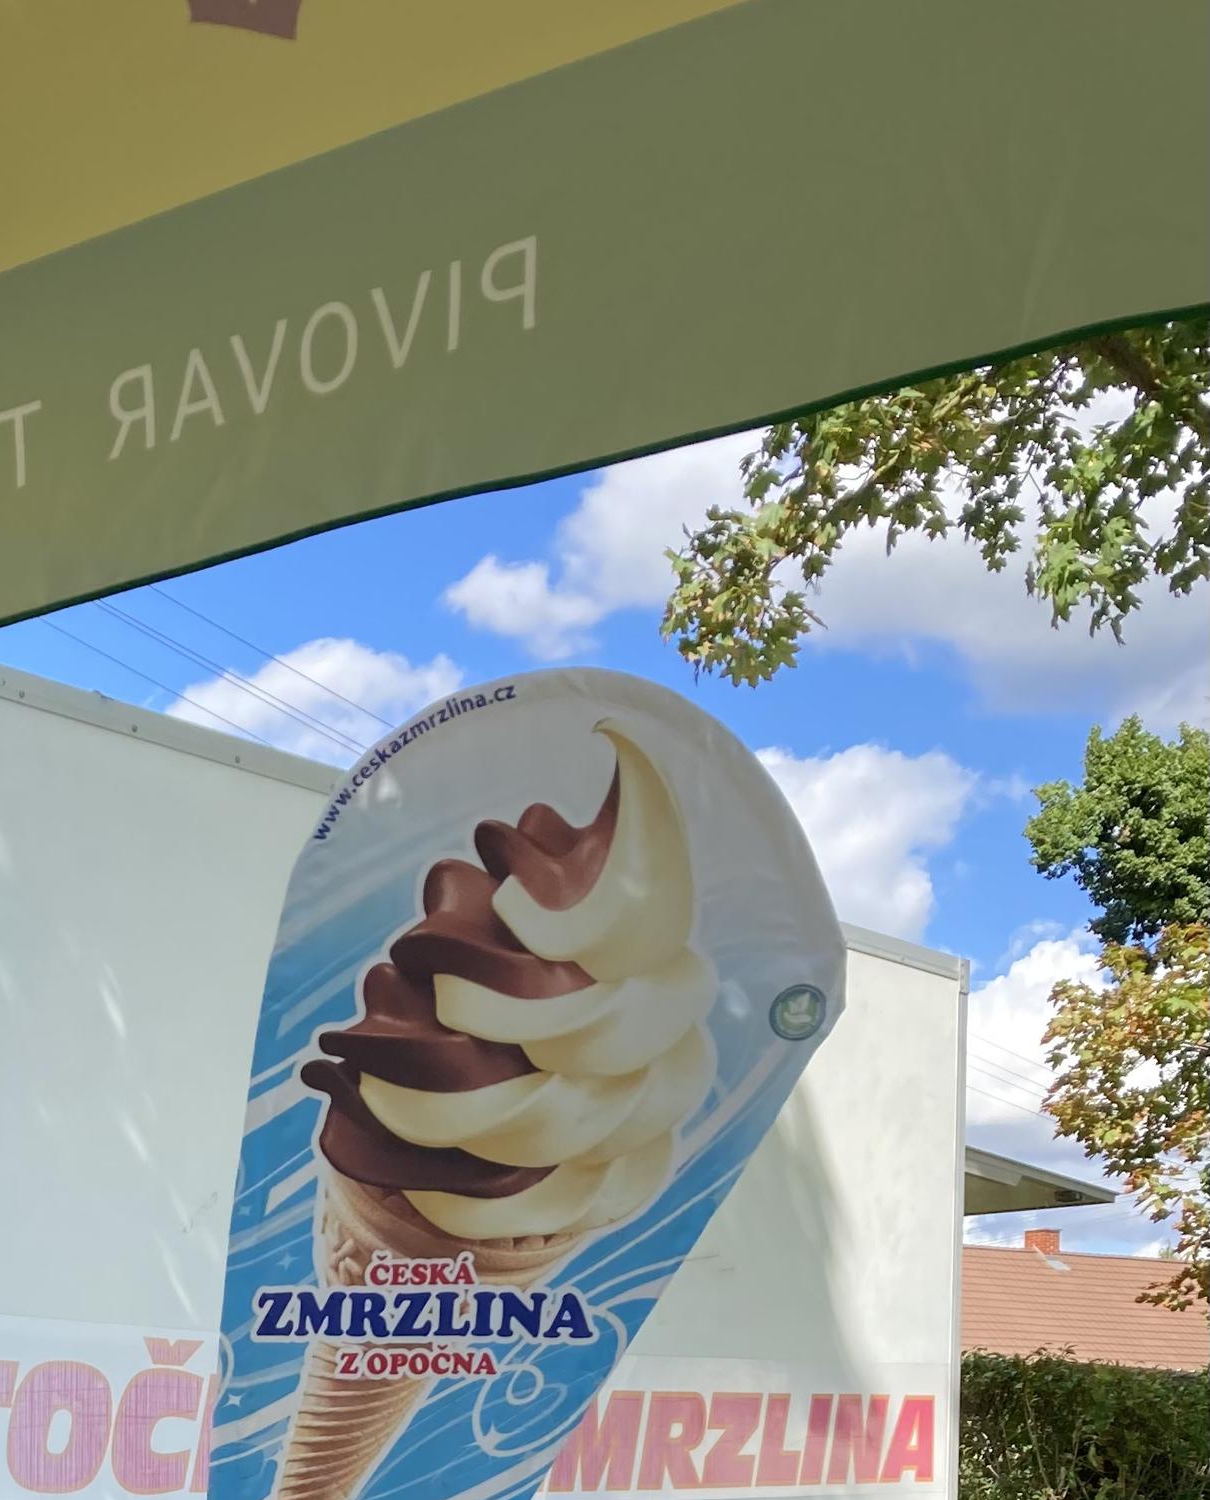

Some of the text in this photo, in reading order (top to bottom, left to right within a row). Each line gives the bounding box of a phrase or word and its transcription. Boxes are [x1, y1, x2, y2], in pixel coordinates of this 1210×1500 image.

[313, 684, 517, 841] www.ceskazmrzlina.cz
[369, 1253, 475, 1286] ČESKÁ
[255, 1291, 594, 1339] ZMRZLINA
[340, 1344, 497, 1376] Z OPOČNA
[538, 1390, 935, 1493] MRZLINA
